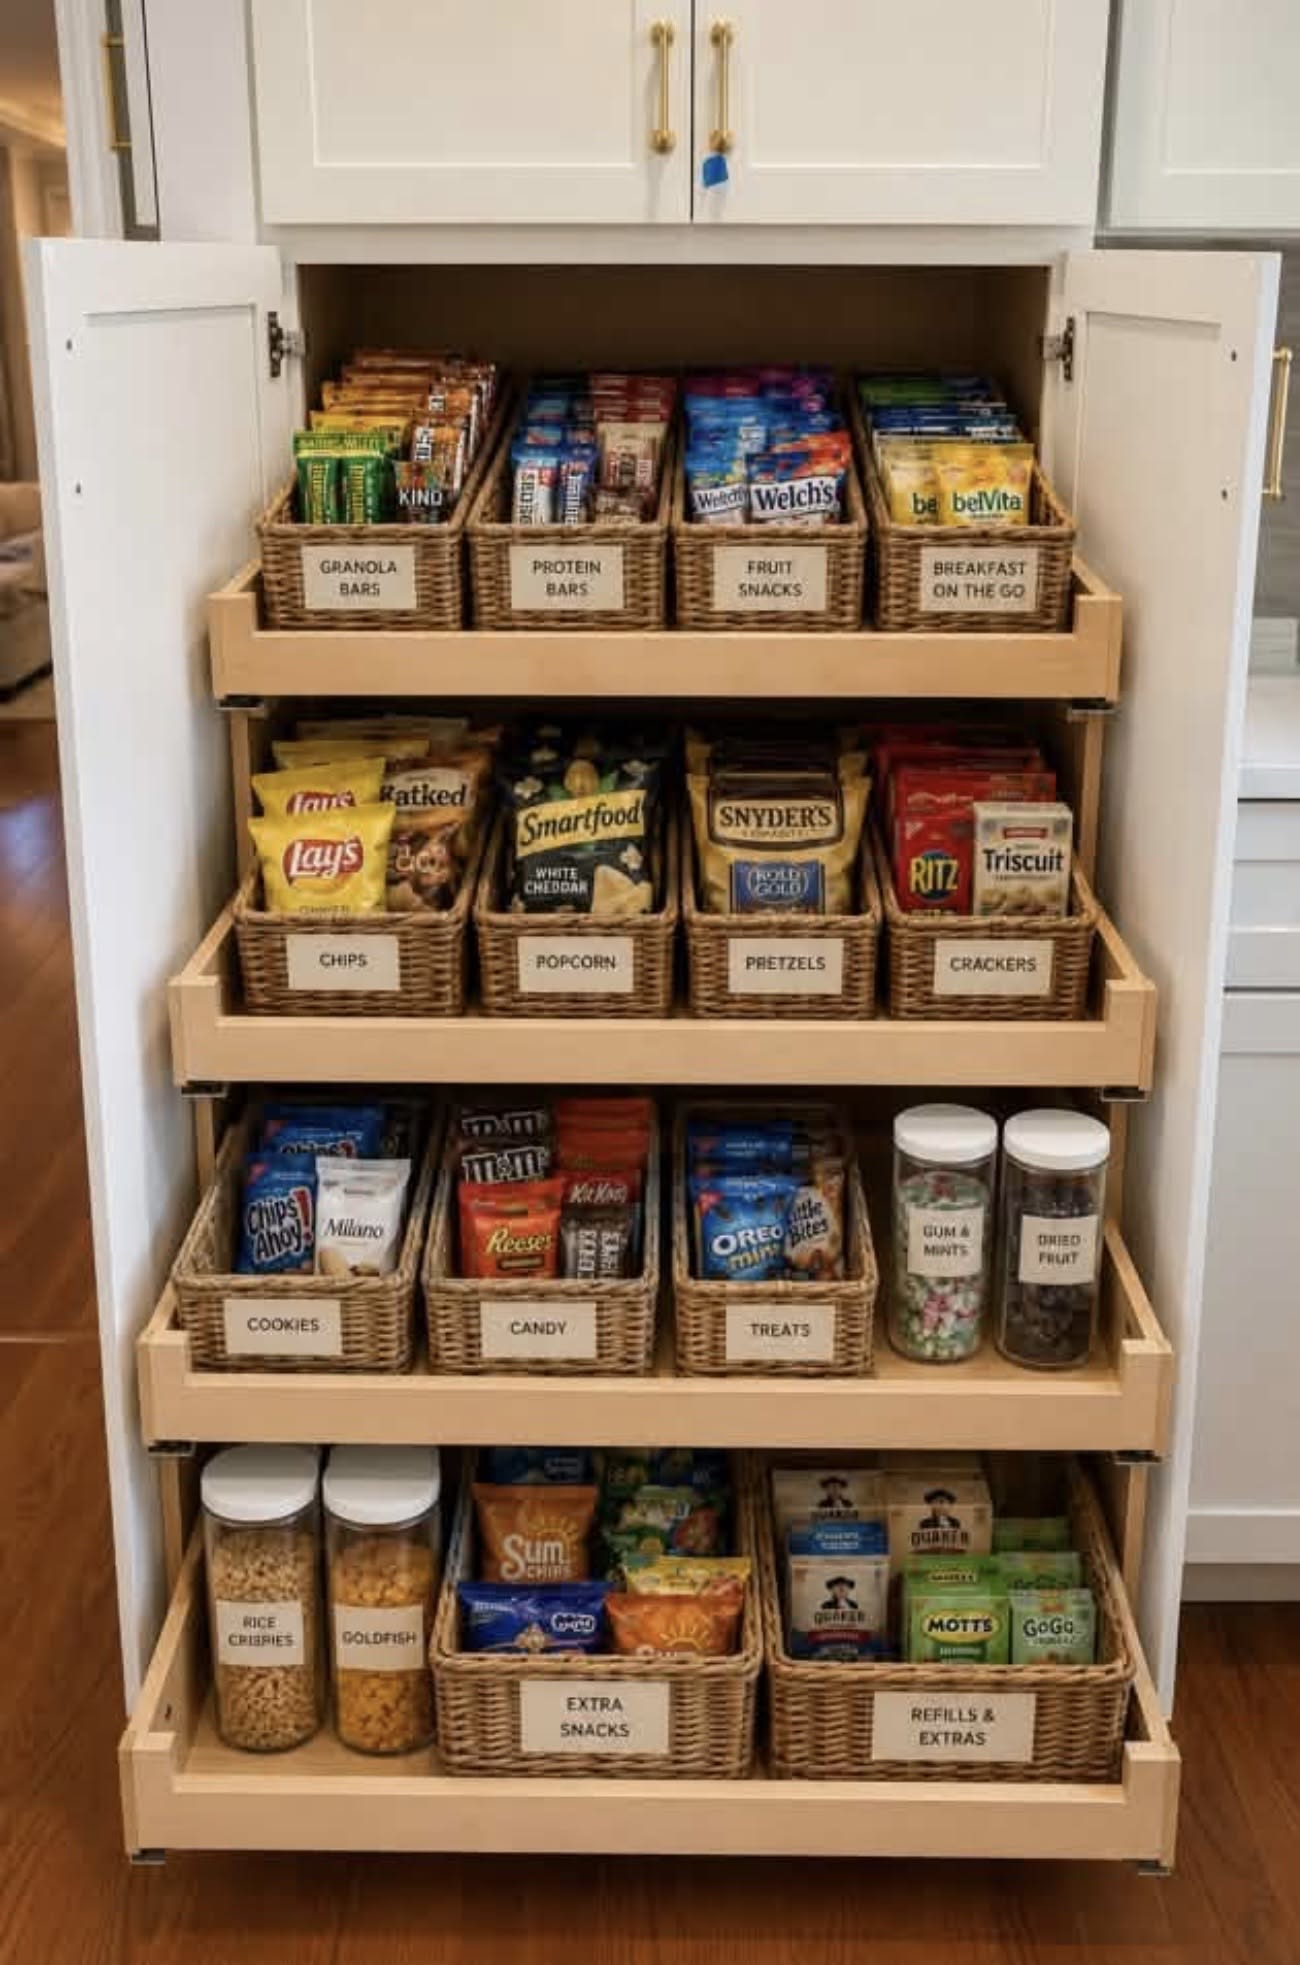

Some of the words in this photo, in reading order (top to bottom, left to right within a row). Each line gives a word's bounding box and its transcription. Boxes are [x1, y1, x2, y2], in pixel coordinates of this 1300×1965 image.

[399, 487, 443, 506] KIND
[754, 480, 836, 512] Welch's
[953, 489, 1021, 513] belVita
[319, 559, 398, 575] GRANOLA
[532, 559, 601, 575] PROTEIN
[747, 560, 793, 575] FRUIT
[933, 560, 1027, 577] BREAKFAST
[339, 581, 381, 597] BARS
[545, 582, 588, 597] BARS
[738, 582, 803, 598] SNACKS
[932, 583, 959, 598] ON
[964, 583, 995, 598] THE
[999, 583, 1027, 599] GO
[520, 797, 640, 846] Smartfood
[983, 847, 1064, 874] Triscuit
[536, 867, 578, 879] WHITE
[911, 857, 959, 893] RITZ
[525, 881, 589, 895] CHEDDAR
[319, 953, 368, 968] CHIPS
[535, 954, 617, 970] POPCORN
[745, 955, 826, 971] PRETZELS
[949, 956, 1037, 973] CRACKERS
[247, 1197, 299, 1236] Chips
[323, 1217, 384, 1240] Milano
[921, 1225, 955, 1239] GUM
[959, 1225, 971, 1239] &
[711, 1226, 784, 1256] OREO
[1037, 1233, 1082, 1247] DRIED
[922, 1243, 969, 1257] MINTS
[1038, 1251, 1079, 1266] FRUIT
[246, 1317, 320, 1333] COOKIES
[510, 1321, 567, 1336] CANDY
[749, 1322, 811, 1338] TREATS
[242, 1615, 276, 1630] RICE
[342, 1631, 418, 1646] GOLDFISH
[566, 1696, 624, 1713] EXTRA
[911, 1707, 978, 1723] REFILLS
[982, 1708, 995, 1723] &
[560, 1722, 630, 1738] SNACKS
[919, 1730, 988, 1746] EXTRAS
